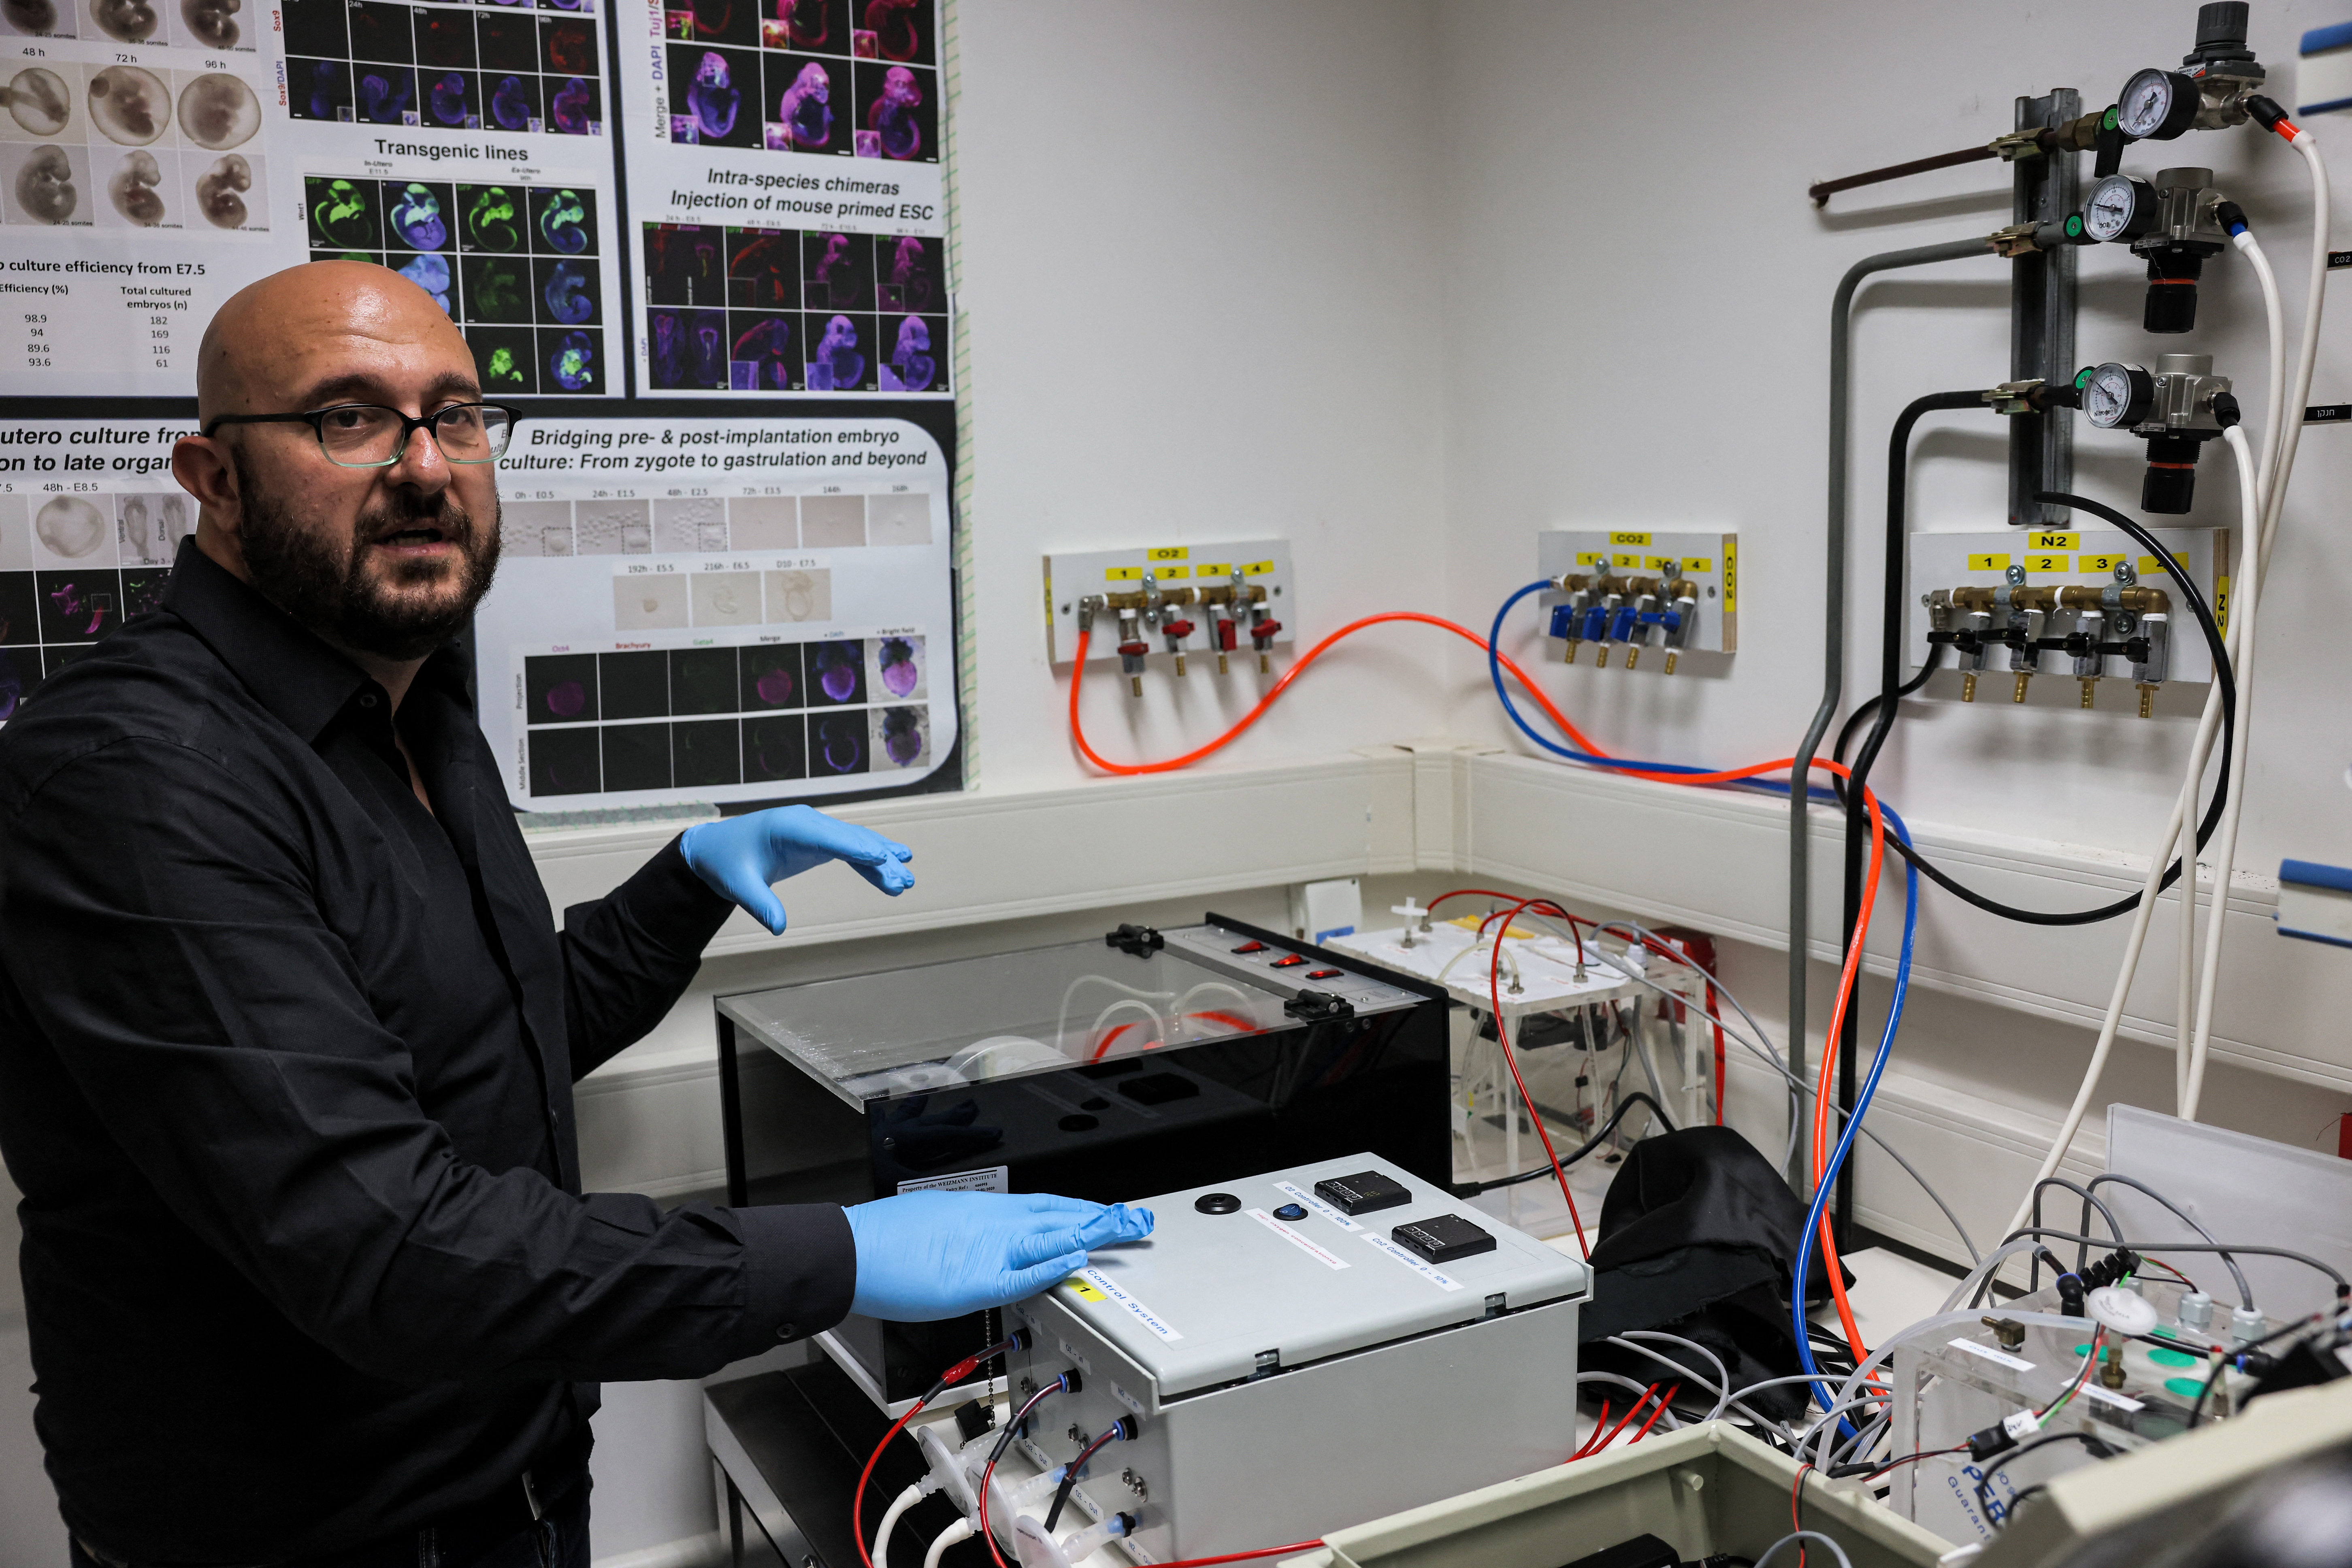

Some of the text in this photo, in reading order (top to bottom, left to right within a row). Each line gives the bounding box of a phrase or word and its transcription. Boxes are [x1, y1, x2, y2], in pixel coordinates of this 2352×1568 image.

[273, 10, 281, 32] Sox9
[22, 47, 45, 57] 48 h
[115, 54, 137, 63] 72 h
[652, 45, 664, 81] DAPI
[205, 60, 226, 69] 96 h
[276, 60, 287, 107] Sox9/DAPI
[655, 96, 667, 139] Merge
[375, 138, 528, 161] Transgenic lines
[708, 168, 900, 196] Intra-species chimeras
[671, 189, 933, 222] Injection of mouse primed ESC
[2335, 256, 2351, 264] CO2
[9, 261, 206, 276] culture efficiency from E7.5
[0, 284, 68, 296] Efficiency (%)
[121, 286, 192, 296] Total cultured
[127, 300, 188, 311] embryos (n)
[25, 314, 47, 323] 98.9
[150, 316, 167, 325] 182
[31, 329, 43, 337] 94
[151, 330, 169, 339] 169
[28, 344, 50, 353] 89.6
[153, 345, 170, 354] 116
[29, 358, 51, 367] 93.6
[156, 359, 168, 368] 61
[1, 428, 150, 444] utero culture
[532, 428, 899, 449] Bridging pre- & post-implantation embryo
[34, 455, 56, 471] to
[64, 454, 105, 471] late
[500, 451, 927, 471] culture: From zygote to gastrulation and beyond
[43, 483, 98, 492] 48h E8.5
[691, 488, 708, 496] E2.5
[765, 486, 781, 494] E3.5
[536, 490, 554, 499] E0.5
[592, 490, 635, 498] 24h E1.5
[1617, 534, 1644, 543] CO2
[2041, 536, 2067, 546] N2
[1157, 549, 1179, 558] O2
[776, 560, 792, 568] D10
[1622, 557, 1630, 565] 2
[1655, 560, 1662, 568] 3
[1692, 561, 1700, 569] 4
[1984, 558, 1992, 567] 1
[2041, 559, 2052, 569] 2
[2096, 559, 2107, 568] 3
[628, 564, 674, 573] 192h E5.5
[1167, 569, 1176, 577] 2
[1210, 566, 1219, 574] 3
[1120, 570, 1127, 578] 1
[2216, 594, 2225, 628] N2
[938, 1178, 968, 1187] WEIZMANN
[969, 1173, 997, 1182] INSTITUTE
[1285, 1185, 1295, 1193] O2
[1294, 1191, 1323, 1210] Controller
[1335, 1215, 1351, 1227] 100%
[1255, 1212, 1269, 1222] High
[1270, 1221, 1291, 1235] oxygen
[1372, 1237, 1387, 1246] Co2
[1386, 1245, 1419, 1268] Controller
[1434, 1275, 1449, 1285] 10%
[1079, 1285, 1091, 1294] 1
[1087, 1269, 1168, 1336] Control System
[1030, 1316, 1035, 1324] in
[1065, 1344, 1084, 1363] O2 in
[1117, 1387, 1125, 1396] N2
[1024, 1440, 1048, 1466] Co2 Out
[1076, 1489, 1098, 1516] O2 Out
[1129, 1542, 1136, 1552] N2
